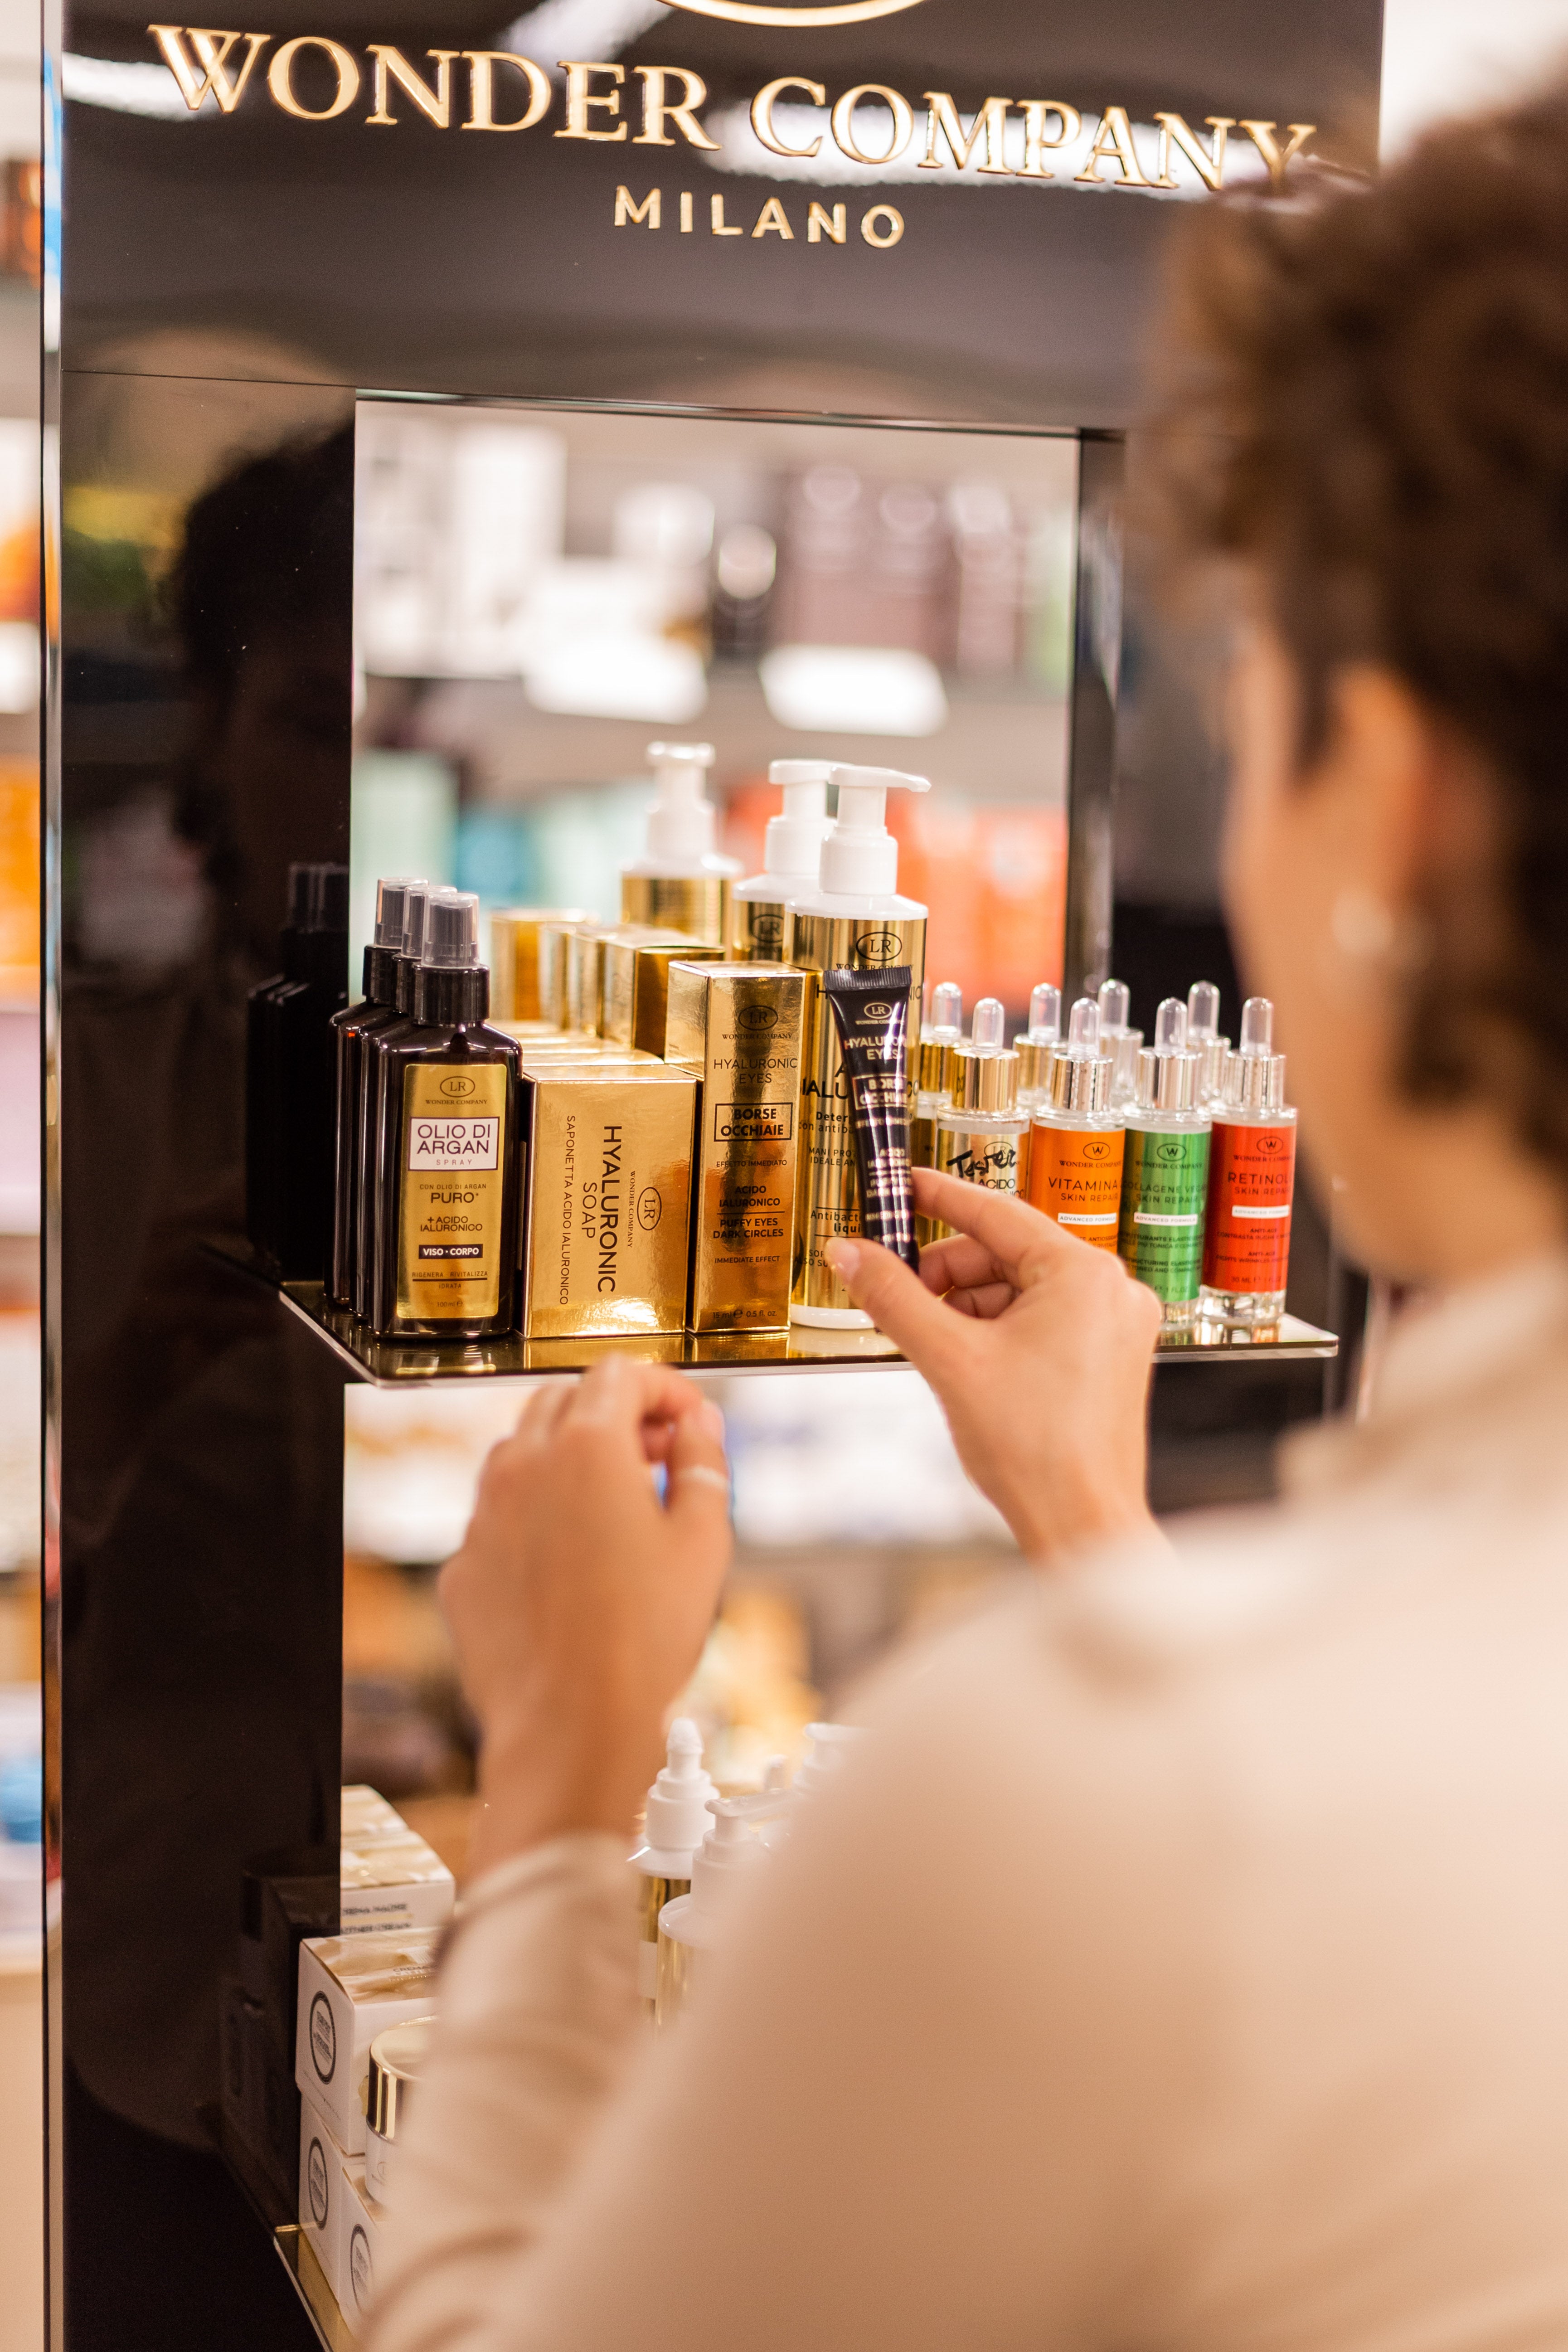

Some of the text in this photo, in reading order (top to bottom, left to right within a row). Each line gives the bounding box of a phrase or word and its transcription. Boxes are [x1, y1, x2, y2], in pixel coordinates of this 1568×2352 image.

[147, 24, 1317, 191] WONDER COMPANY
[614, 185, 905, 248] MILANO
[870, 939, 892, 953] LR
[872, 1006, 886, 1015] LR
[749, 1012, 767, 1024] LR
[714, 1058, 798, 1069] HYALURONIC
[739, 1073, 772, 1084] EYES
[450, 1082, 466, 1091] LR
[734, 1108, 777, 1120] BORSE
[417, 1124, 490, 1139] OLIO DI
[721, 1124, 784, 1137] OCCHIAIE
[417, 1140, 489, 1155] ARGAN
[809, 1147, 830, 1156] MANI
[810, 1157, 842, 1166] IDEALE
[1049, 1176, 1117, 1191] VITAMINA
[735, 1185, 767, 1194] ACIDO
[719, 1198, 781, 1207] IALURONICO
[1061, 1193, 1085, 1201] SKIN
[1136, 1194, 1160, 1203] SKIN
[560, 1115, 576, 1305] SAPONETTA ACIDO IALURONICO
[581, 1182, 597, 1239] SOAP
[597, 1126, 622, 1293] HYALURONIC
[644, 1199, 655, 1220] LR
[421, 1224, 483, 1232] IALURONICO
[720, 1218, 778, 1227] PUFFY EYES
[713, 1229, 784, 1239] DARK CIRCLES
